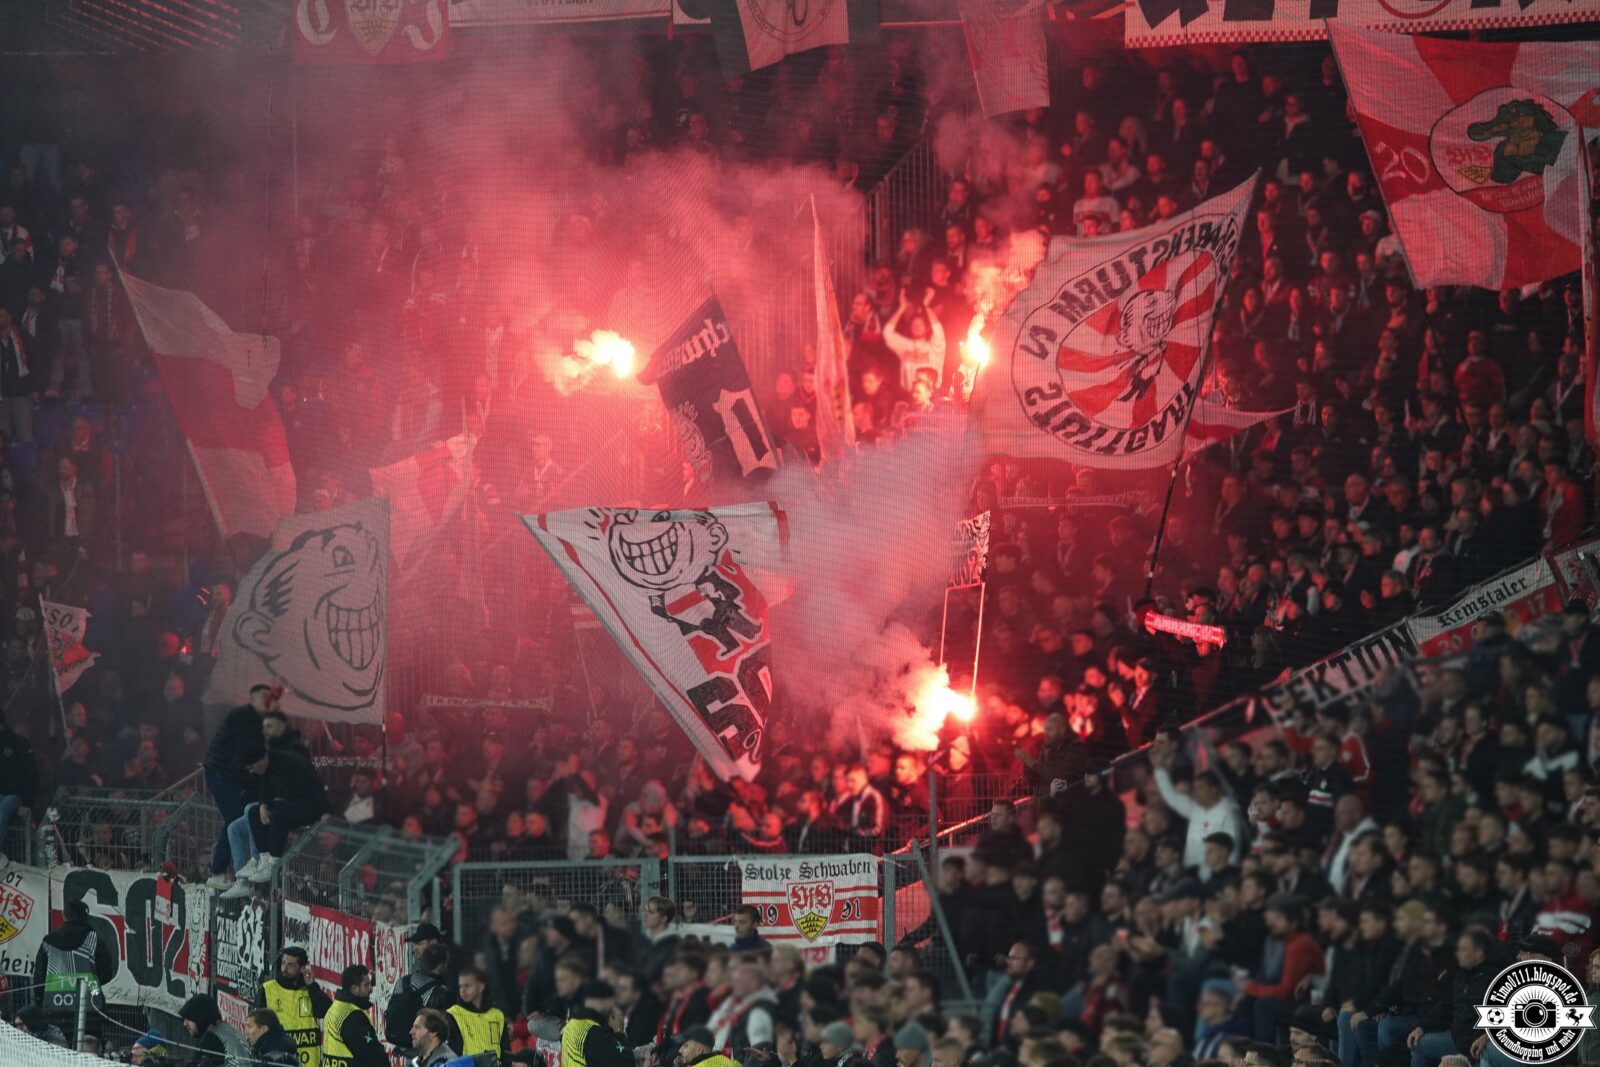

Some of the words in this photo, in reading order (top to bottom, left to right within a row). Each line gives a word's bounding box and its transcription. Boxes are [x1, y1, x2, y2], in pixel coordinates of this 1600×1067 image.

[1376, 141, 1430, 184] 20
[744, 863, 792, 884] Stolze
[798, 859, 872, 880] Schwaben
